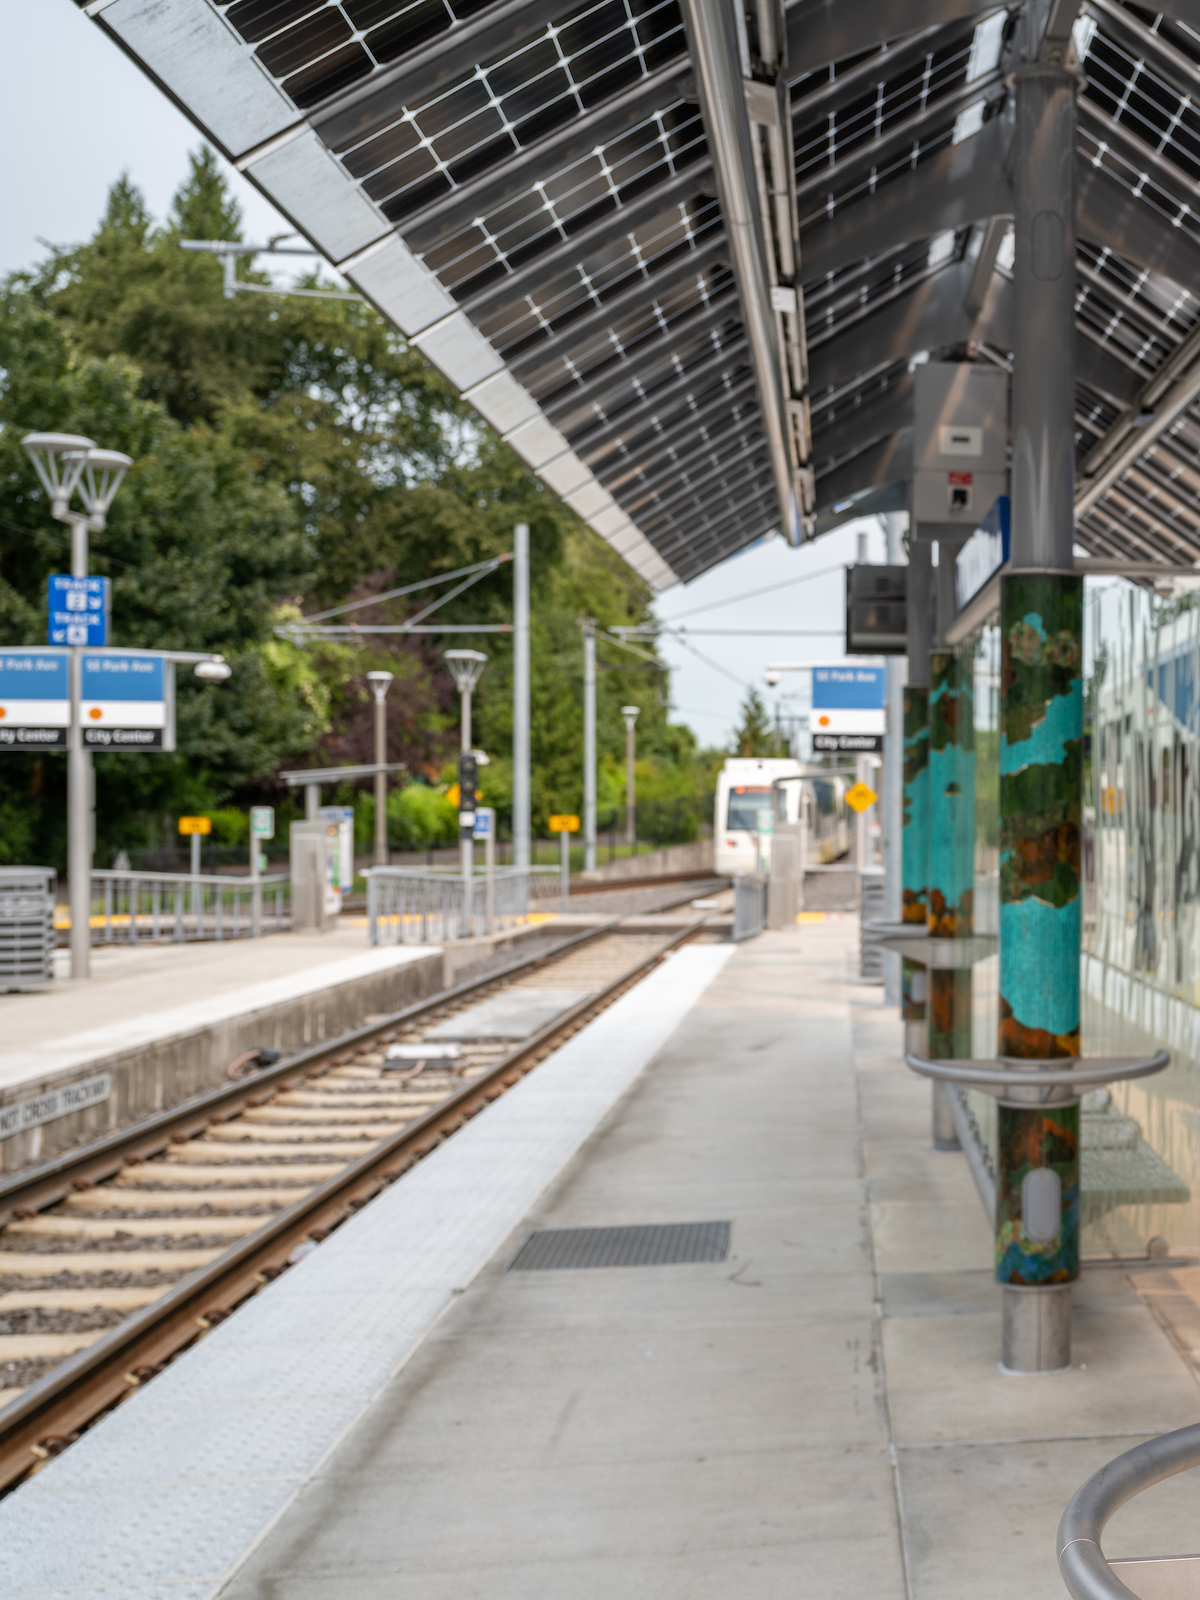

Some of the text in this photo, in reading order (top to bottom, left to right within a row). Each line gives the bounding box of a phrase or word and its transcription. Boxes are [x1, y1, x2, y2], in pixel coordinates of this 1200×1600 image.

[54, 577, 101, 593] TRACK
[54, 611, 101, 626] TRACK
[6, 657, 34, 672] Park
[35, 658, 59, 672] Ave
[86, 658, 155, 674] SE Park Ave
[0, 728, 60, 745] ity Center
[85, 729, 155, 745] City Center
[814, 736, 877, 751] City Center
